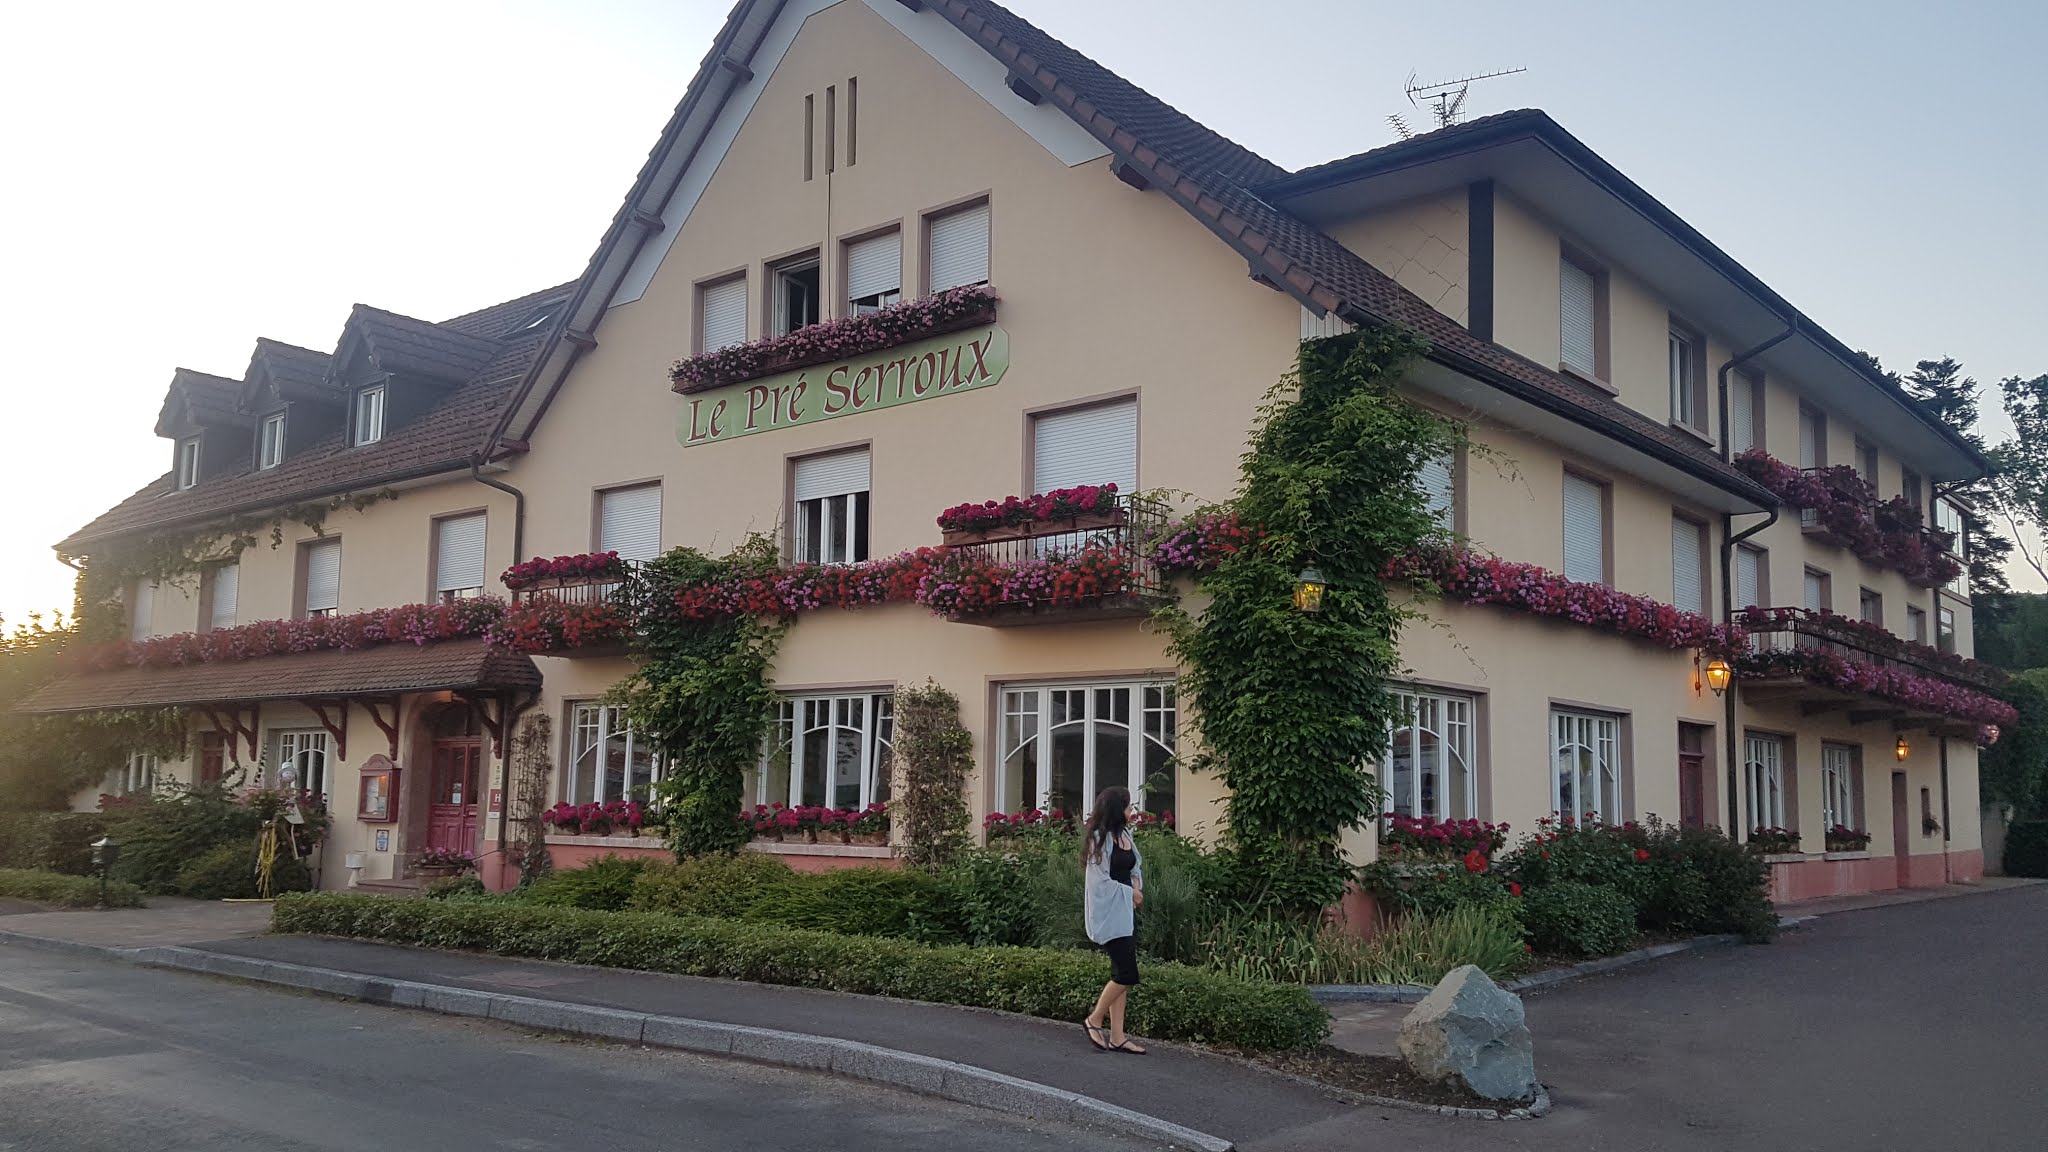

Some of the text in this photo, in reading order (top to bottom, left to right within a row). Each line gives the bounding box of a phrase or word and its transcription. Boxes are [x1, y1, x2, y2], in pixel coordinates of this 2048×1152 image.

[687, 331, 993, 442] Le Pré Serroux
